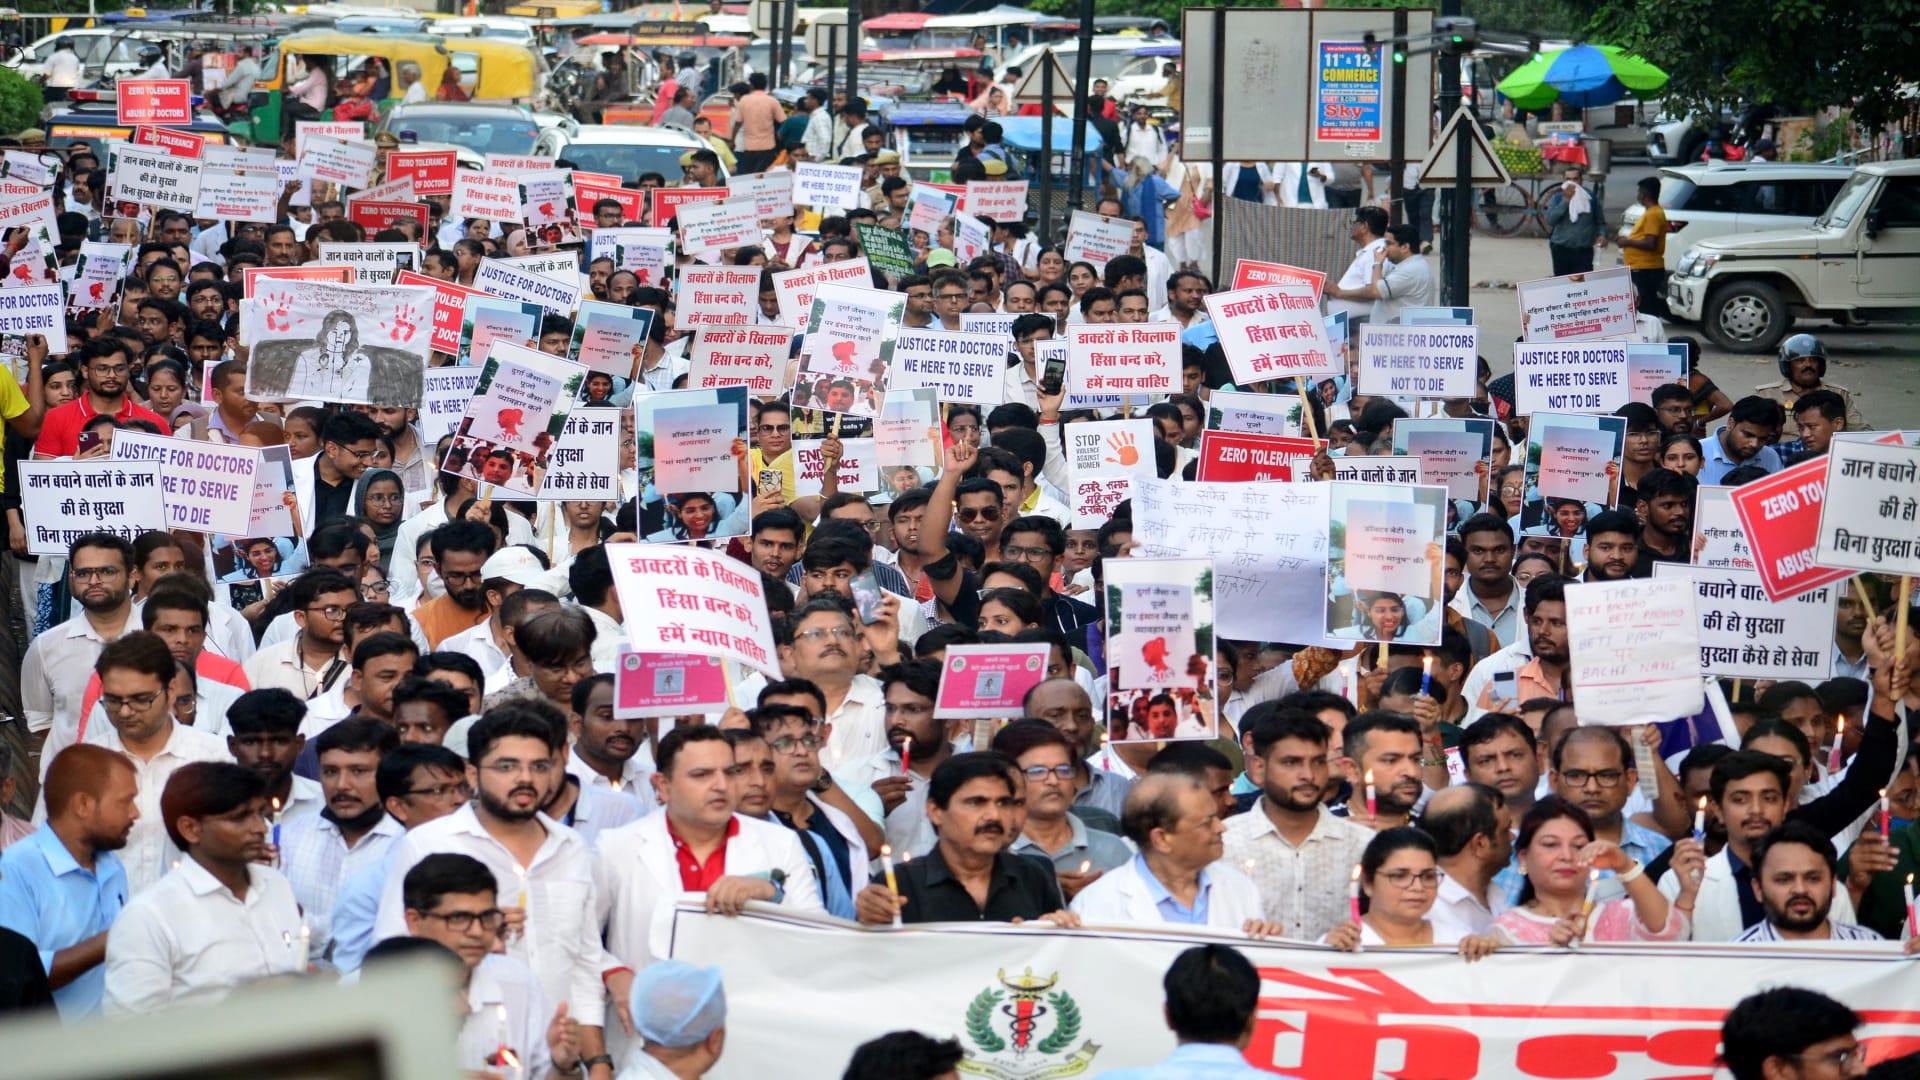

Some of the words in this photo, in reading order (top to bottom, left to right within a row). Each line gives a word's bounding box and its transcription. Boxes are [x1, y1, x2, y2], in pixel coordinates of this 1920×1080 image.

[1323, 68, 1378, 82] COMMERCE
[128, 87, 144, 96] ZERO
[145, 87, 181, 96] TOLERANCE
[157, 109, 185, 118] DOCTORS
[1325, 104, 1363, 120] Sky
[398, 159, 414, 167] ZERO
[415, 157, 448, 166] TOLERANCE
[800, 168, 820, 178] JUSTICE
[822, 170, 832, 179] FOR
[834, 170, 860, 180] DOCTORS
[802, 182, 809, 191] WE
[810, 182, 824, 192] HERE
[826, 184, 834, 192] TO
[834, 184, 852, 194] SERVE
[326, 252, 341, 264] जान
[343, 250, 364, 265] बचाने
[366, 248, 384, 265] वालों
[386, 249, 394, 262] के
[688, 272, 716, 284] डाक्टरों
[718, 272, 725, 284] के
[726, 272, 757, 285] खिलाफ
[783, 274, 815, 288] डाक्टरों
[817, 270, 827, 284] के
[829, 265, 866, 282] खिलाफ
[1246, 269, 1266, 281] ZERO
[482, 266, 516, 287] JUSTICE
[517, 276, 534, 292] FOR
[535, 282, 574, 305] DOCTORS
[0, 297, 16, 311] FOR
[18, 293, 59, 308] DOCTORS
[1224, 294, 1266, 318] डाक्टरों
[1269, 293, 1282, 311] के
[1282, 292, 1315, 310] खिलाफ
[12, 317, 24, 330] TO
[26, 314, 54, 328] SERVE
[964, 321, 997, 334] JUSTICE
[704, 330, 734, 345] डाक्टरों
[736, 331, 744, 344] के
[748, 331, 788, 346] खिलाफ
[1078, 330, 1114, 345] डाक्टरों
[1118, 332, 1128, 344] के
[1132, 330, 1176, 344] खिलाफ
[1365, 334, 1406, 348] JUSTICE
[1408, 334, 1428, 348] FOR
[1429, 334, 1474, 349] DOCTORS
[897, 336, 936, 354] JUSTICE
[938, 338, 958, 354] FOR
[960, 340, 1004, 356] DOCTORS
[1090, 353, 1116, 368] हिंसा
[1144, 352, 1166, 368] करे,
[1251, 356, 1273, 373] हमें
[1276, 354, 1300, 370] न्याय
[1301, 350, 1328, 368] चाहिए
[1373, 354, 1388, 368] WE
[1390, 355, 1415, 369] HERE
[1418, 356, 1431, 369] TO
[1433, 356, 1464, 370] SERVE
[1520, 352, 1559, 366] JUSTICE
[1562, 351, 1580, 364] FOR
[1583, 350, 1625, 364] DOCTORS
[904, 359, 918, 373] WE
[920, 360, 945, 374] HERE
[948, 362, 961, 374] TO
[962, 362, 994, 378] SERVE
[1086, 376, 1104, 389] हमें
[1106, 376, 1134, 389] न्याय
[1136, 374, 1170, 389] चाहिए
[1390, 376, 1411, 390] NOT
[1414, 377, 1426, 390] TO
[1428, 377, 1444, 392] DIE
[1530, 374, 1544, 387] WE
[1546, 373, 1572, 386] HERE
[1574, 372, 1586, 386] TO
[1588, 372, 1618, 386] SERVE
[943, 382, 956, 396] TO
[958, 384, 974, 398] DIE
[1548, 395, 1568, 408] NOT
[1570, 394, 1582, 408] TO
[1585, 394, 1600, 408] DIE
[580, 420, 589, 435] के
[592, 420, 614, 436] जान
[1075, 434, 1100, 447] STOP
[554, 446, 584, 468] सुरक्षा
[1076, 446, 1100, 454] VIOLENCE
[1076, 454, 1100, 462] AGAINST
[1220, 446, 1247, 464] ZERO
[118, 442, 167, 462] JUSTICE
[170, 450, 192, 467] FOR
[198, 454, 254, 476] DOCTORS
[1077, 462, 1100, 470] WOMEN
[1361, 465, 1386, 483] वालों
[1386, 466, 1396, 482] के
[1398, 468, 1416, 484] जान
[1842, 457, 1872, 480] जान
[1878, 455, 1917, 484] बचाने
[28, 473, 50, 488] जान
[53, 469, 82, 488] बचाने
[85, 468, 114, 487] वालों
[116, 470, 127, 486] के
[130, 472, 154, 488] जान
[554, 472, 575, 490] कैसे
[577, 473, 587, 489] हो
[590, 472, 610, 490] सेवा
[181, 478, 196, 494] TO
[200, 480, 238, 501] SERVE
[61, 499, 76, 516] की
[78, 500, 90, 516] हो
[93, 501, 124, 520] सुरक्षा
[1760, 492, 1799, 520] ZERO
[1879, 498, 1898, 520] की
[1902, 498, 1916, 522] हो
[173, 505, 189, 521] TO
[191, 507, 210, 526] DIE
[36, 526, 60, 544] बिना
[1704, 528, 1728, 539] महिला
[1834, 528, 1866, 554] बिना
[1871, 534, 1911, 563] सुरक्षा
[628, 554, 688, 576] डाक्टरों
[694, 559, 710, 578] के
[712, 561, 760, 598] खिलाफ
[1700, 578, 1736, 600] बचाने
[656, 587, 700, 612] हिंसा
[736, 606, 758, 632] करे,
[1704, 610, 1722, 630] की
[1727, 614, 1741, 632] हो
[1745, 617, 1786, 639] सुरक्षा
[658, 625, 686, 645] हमें
[692, 627, 730, 652] न्याय
[734, 640, 767, 665] चाहिए
[1700, 646, 1738, 668] सुरक्षा
[1742, 643, 1770, 665] कैसे
[1773, 647, 1787, 666] हो
[1792, 645, 1820, 667] सेवा
